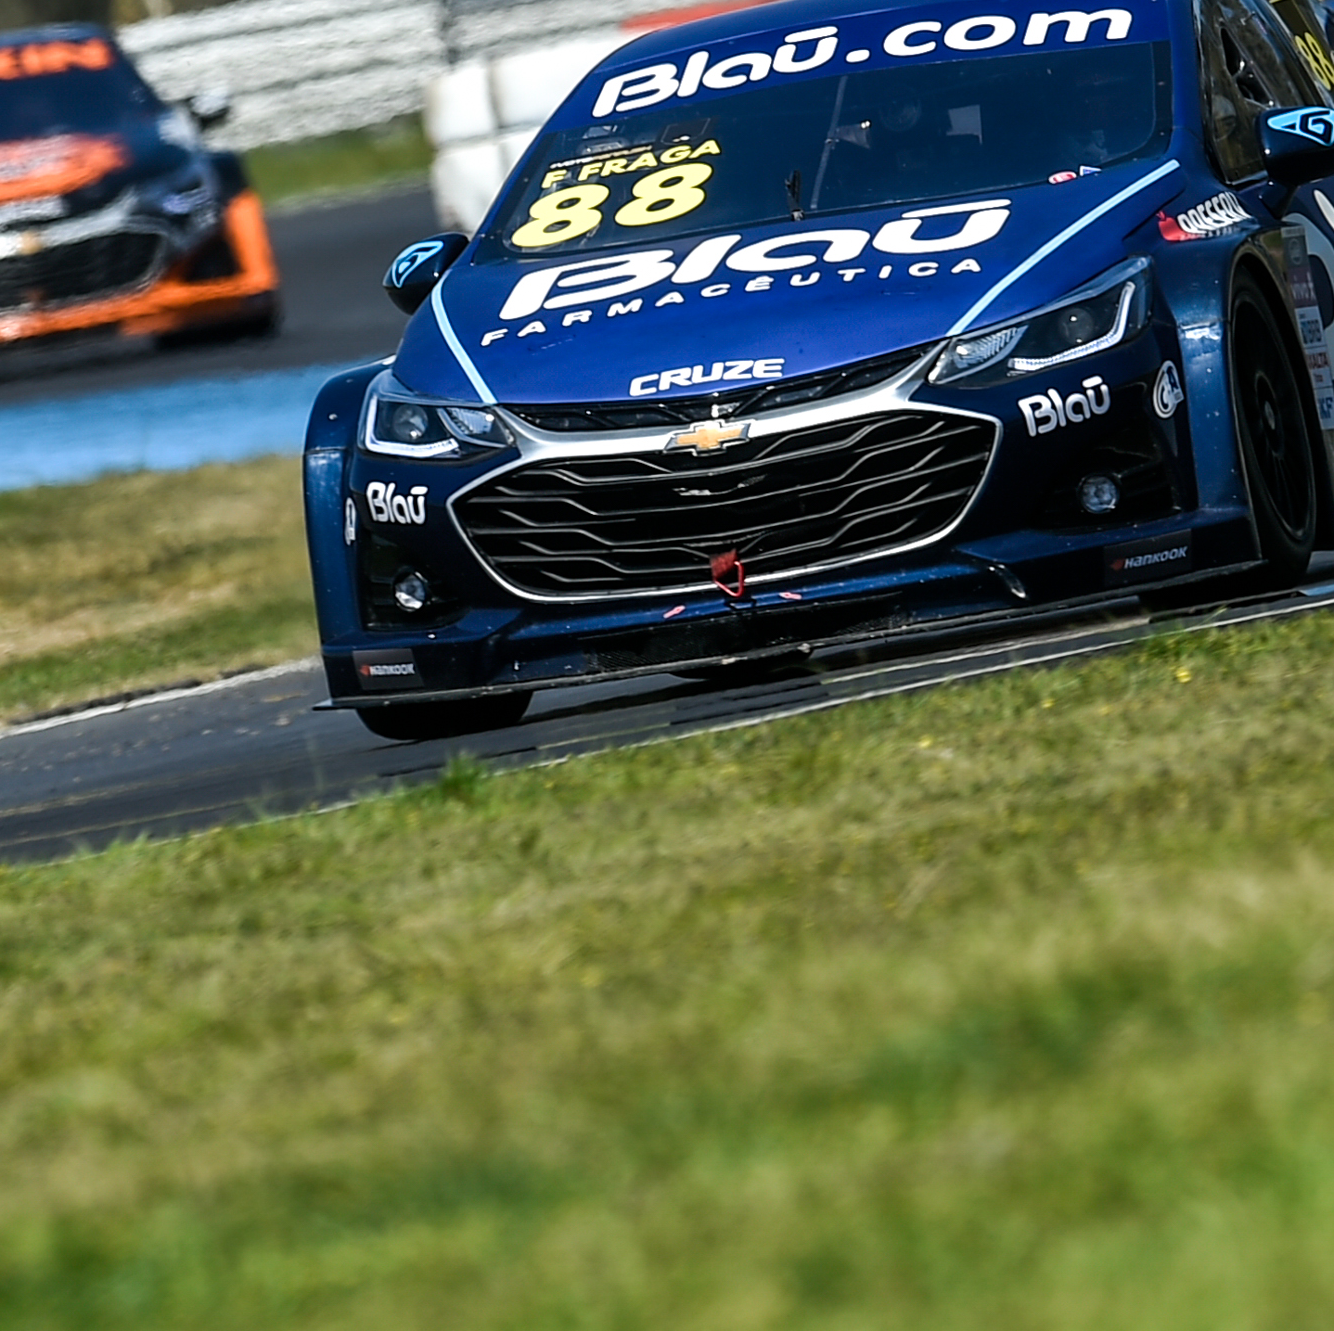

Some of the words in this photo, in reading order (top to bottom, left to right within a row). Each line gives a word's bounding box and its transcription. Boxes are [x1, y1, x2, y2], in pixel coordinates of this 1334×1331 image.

[541, 170, 567, 189] F
[577, 139, 721, 182] FRAGA
[511, 162, 713, 247] 88
[480, 258, 982, 347] FARMACÊUTICA
[629, 358, 785, 398] CRUZE
